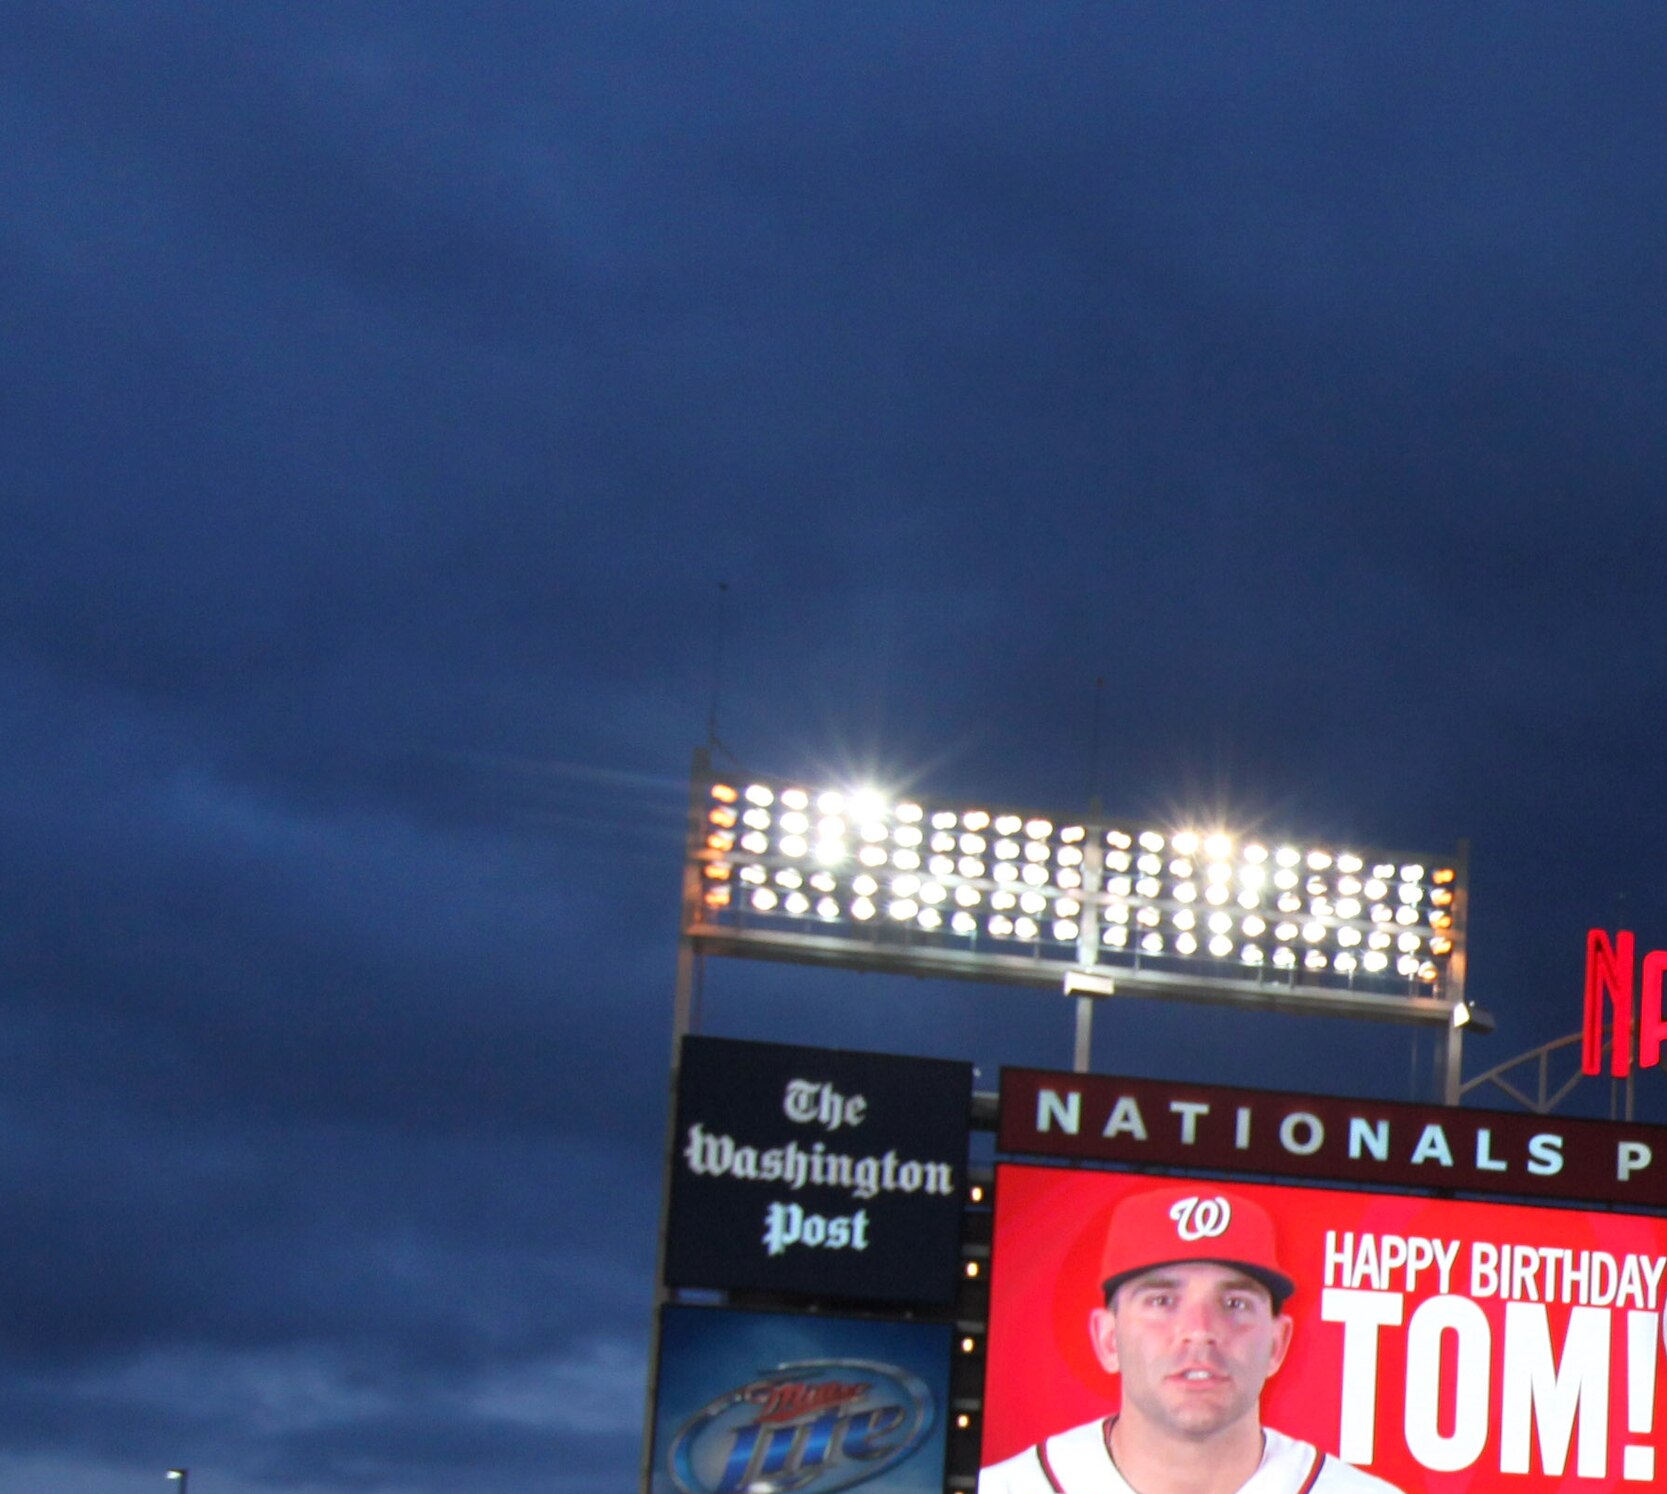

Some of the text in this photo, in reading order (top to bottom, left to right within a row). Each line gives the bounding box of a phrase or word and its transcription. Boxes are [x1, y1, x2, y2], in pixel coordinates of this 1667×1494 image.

[782, 1078, 867, 1131] The
[1036, 1089, 1565, 1176] NATIONALS
[684, 1122, 954, 1199] Washington
[762, 1201, 869, 1256] Post
[1324, 1230, 1667, 1310] HAPPY BIRTHDAY
[1321, 1286, 1660, 1482] TOM!
